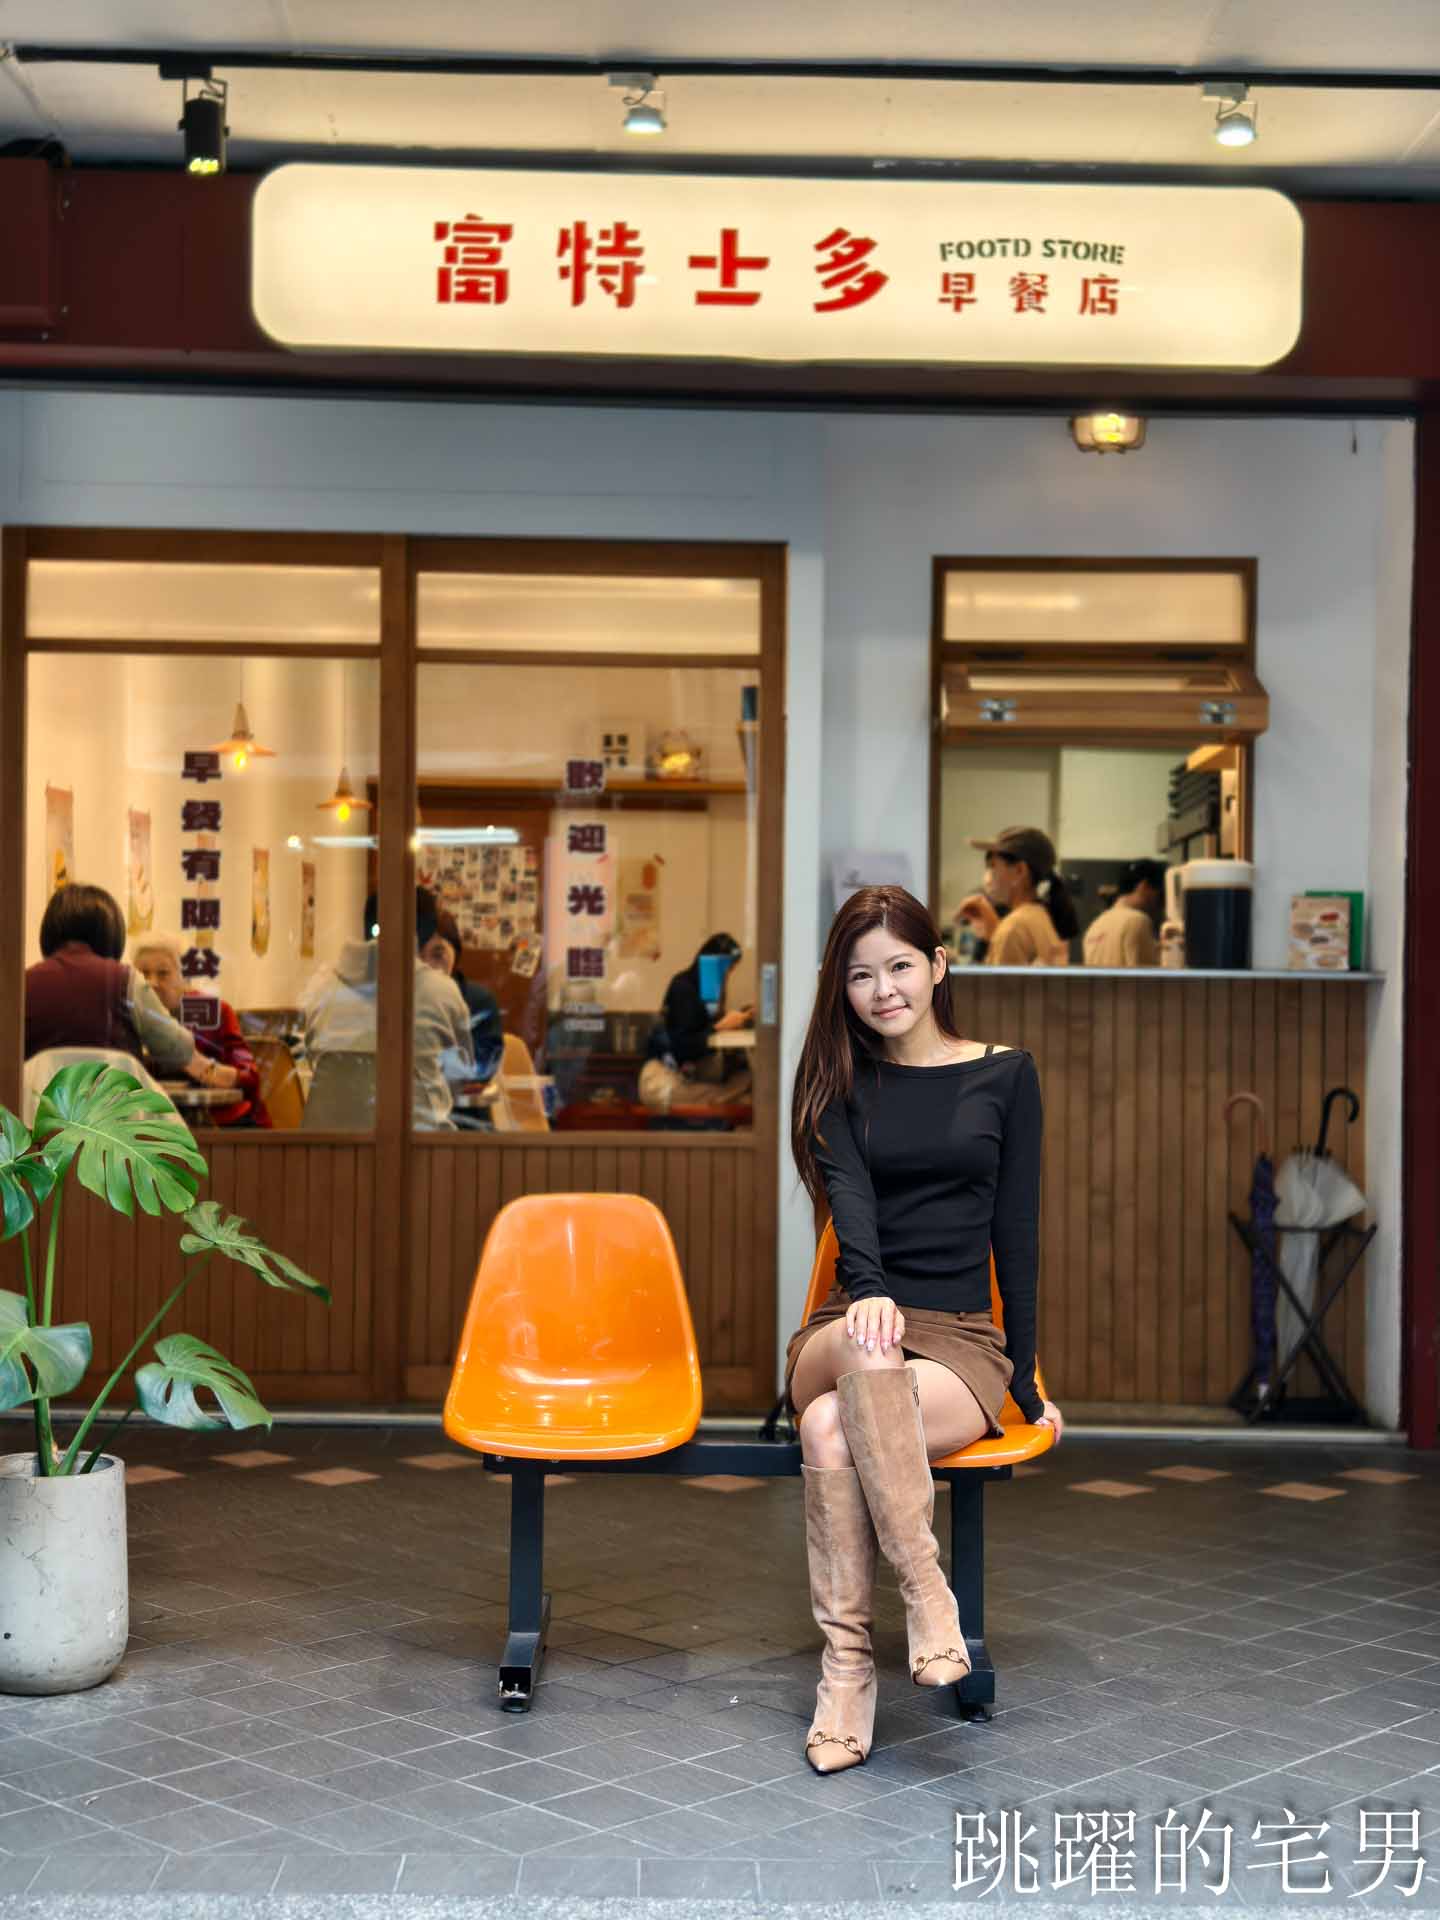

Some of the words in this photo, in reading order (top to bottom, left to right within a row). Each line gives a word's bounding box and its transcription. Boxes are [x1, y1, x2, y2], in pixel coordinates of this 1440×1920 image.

[434, 214, 888, 313] 富特士多
[939, 238, 1032, 262] FOOTD
[1042, 239, 1125, 265] STORE
[938, 272, 1120, 315] 早餐店
[181, 750, 222, 1029] 早餐有限公司
